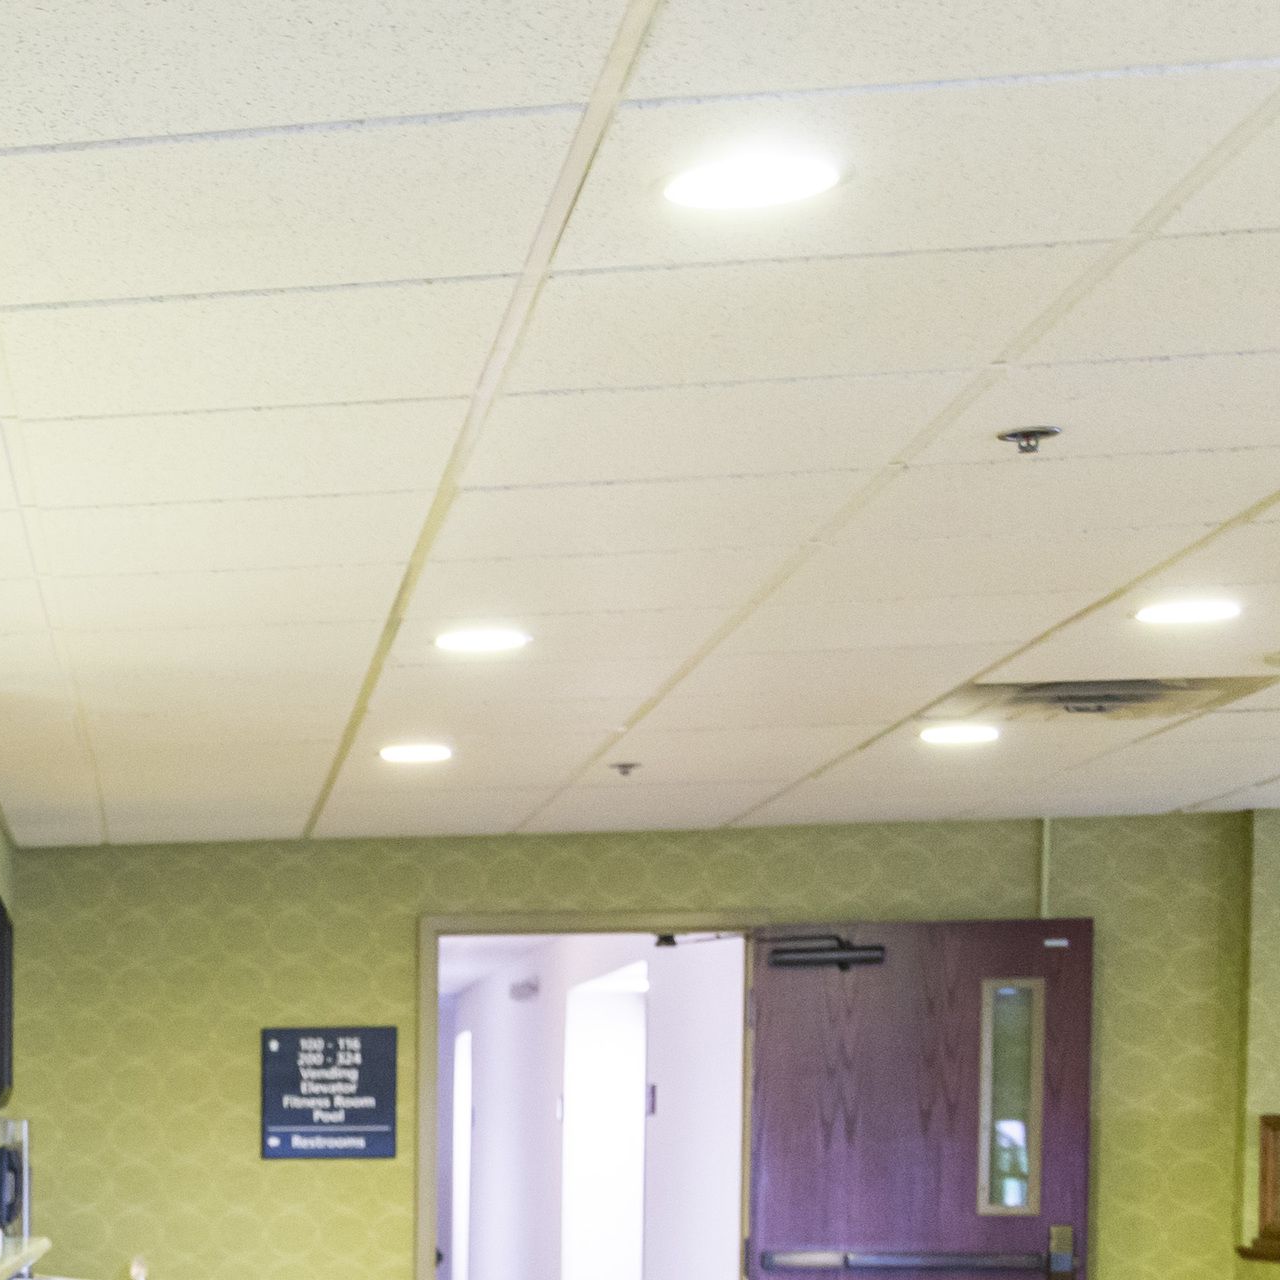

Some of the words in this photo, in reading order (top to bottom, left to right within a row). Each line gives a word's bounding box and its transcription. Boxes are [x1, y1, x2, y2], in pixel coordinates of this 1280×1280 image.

[282, 1095, 331, 1109] Fitness
[333, 1095, 376, 1109] Room
[312, 1108, 345, 1123] Pool
[291, 1135, 366, 1149] Restrooms
